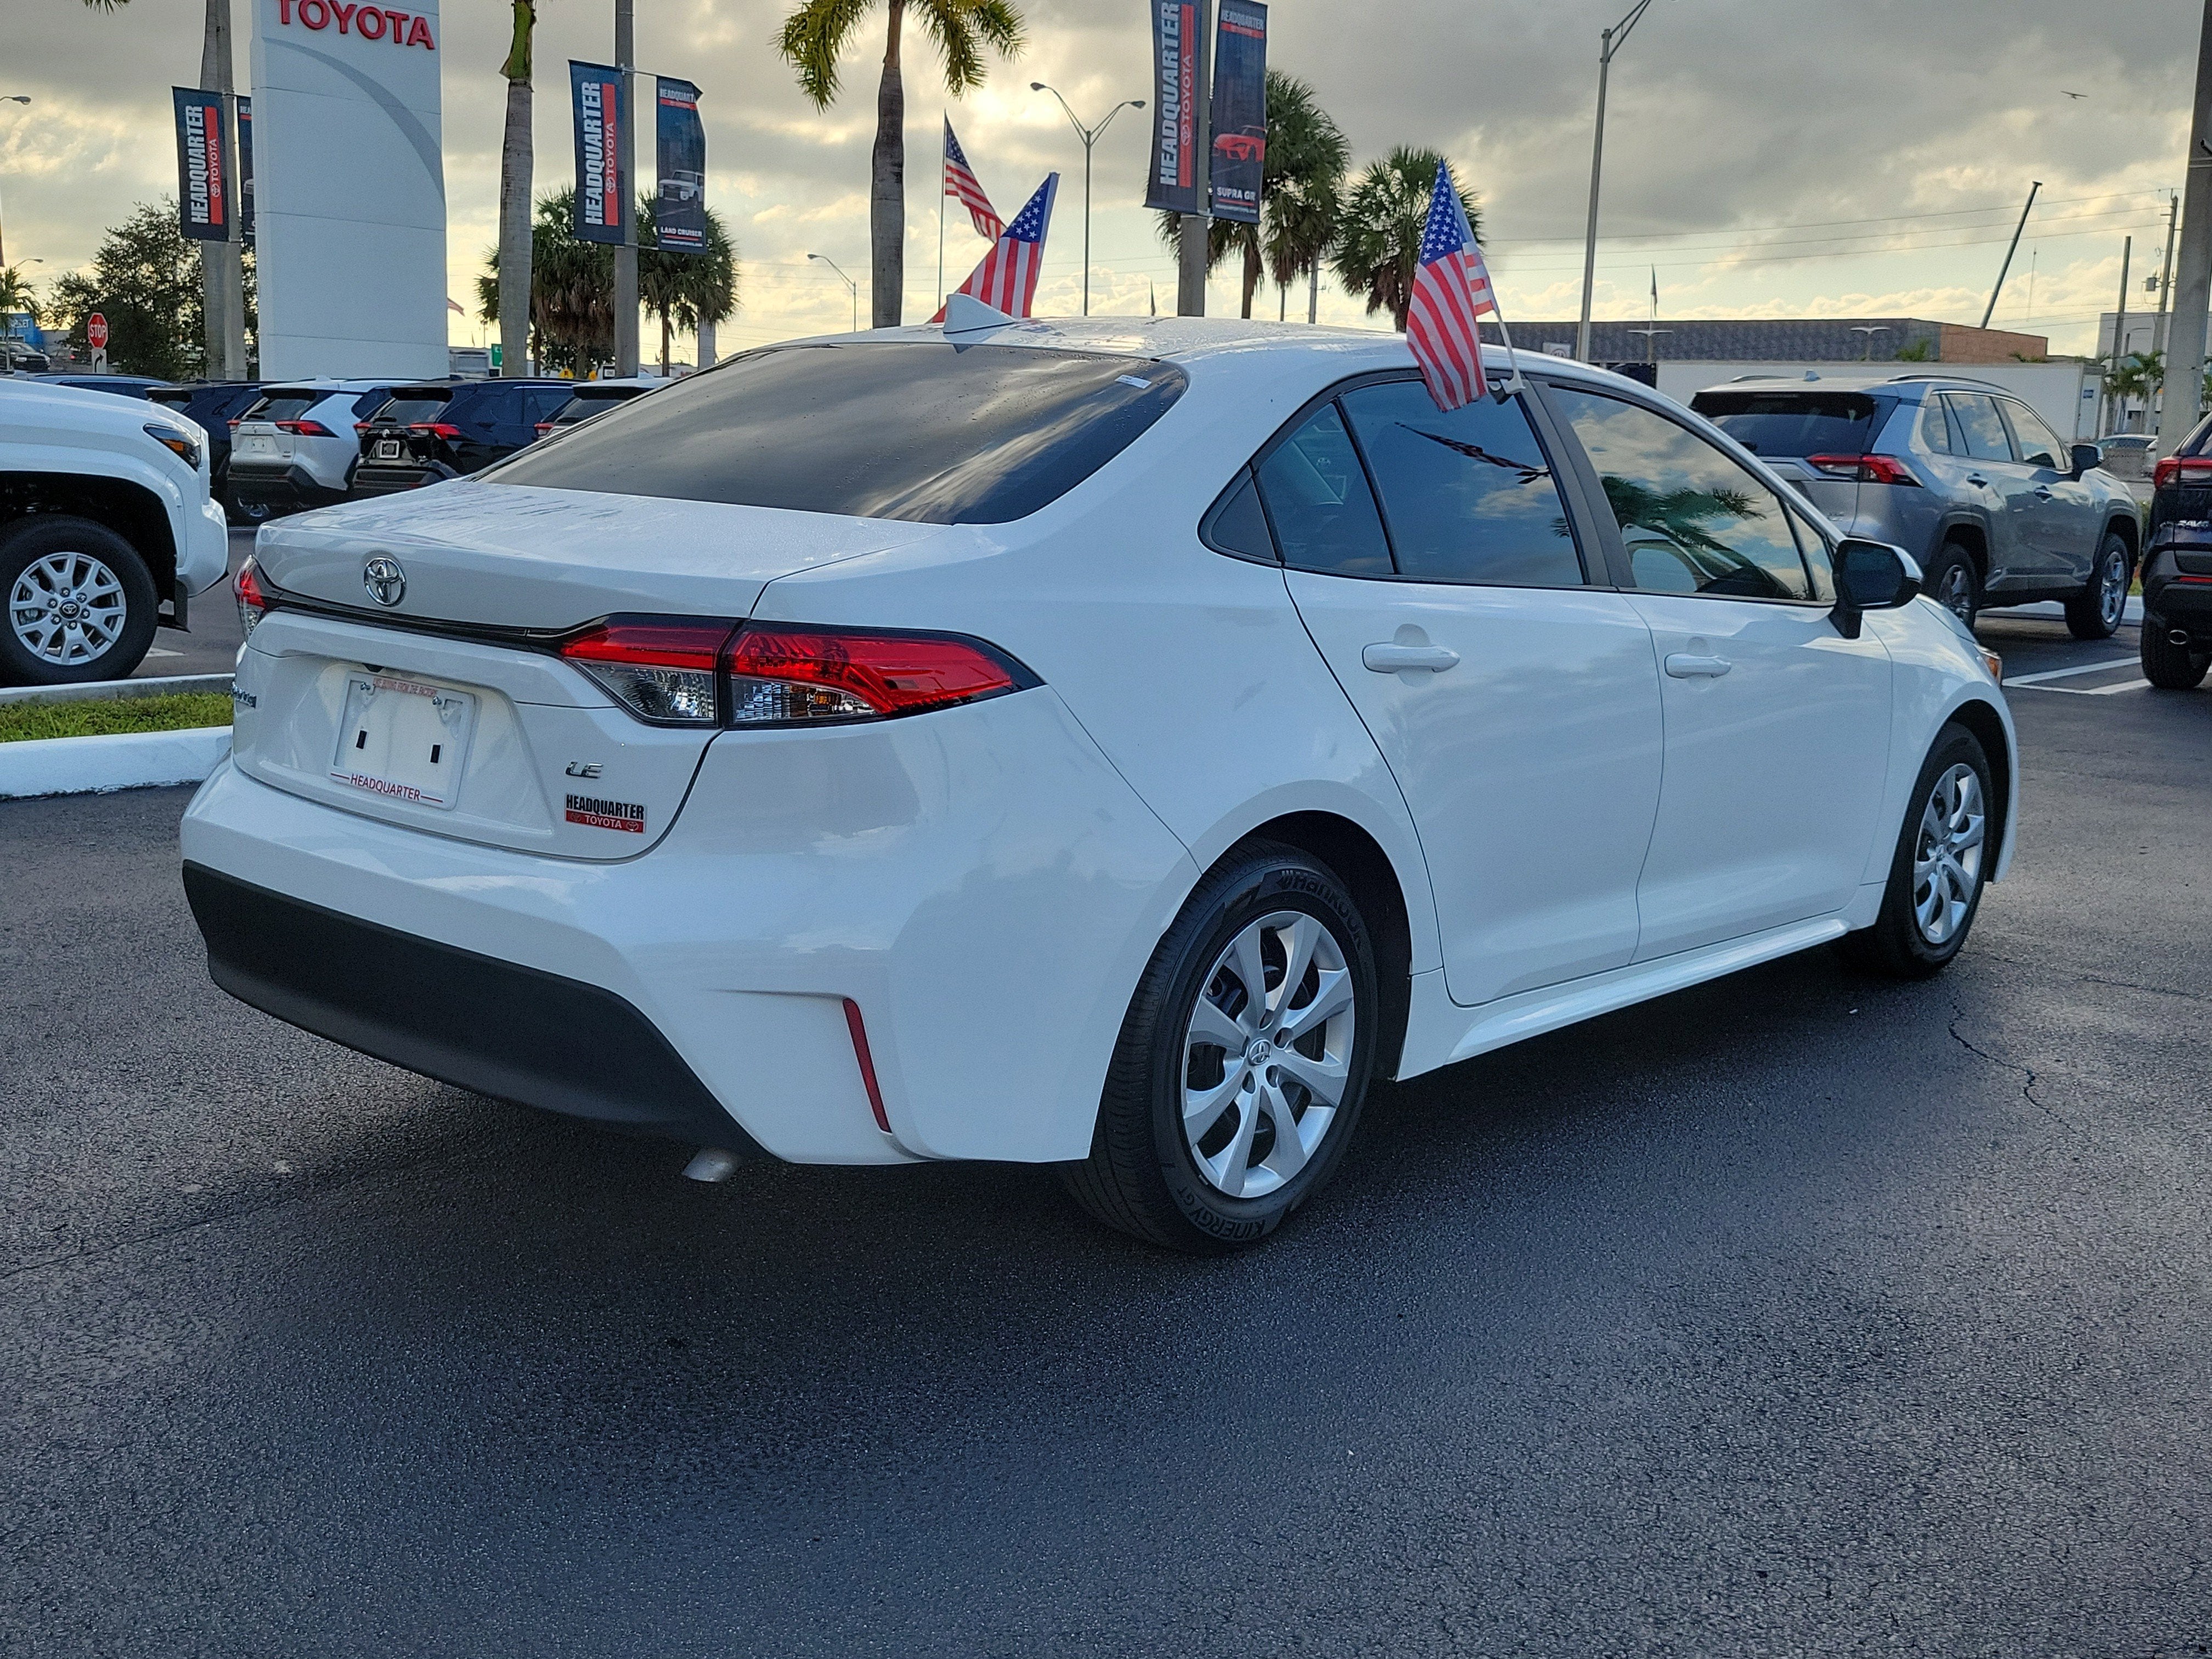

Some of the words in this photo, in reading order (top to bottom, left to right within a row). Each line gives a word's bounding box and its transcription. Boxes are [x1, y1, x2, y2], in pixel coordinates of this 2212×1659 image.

[276, 0, 436, 50] TOYOTA
[1160, 2, 1180, 187] HEADQUARTER
[1182, 55, 1192, 119] TOYOTA
[185, 105, 209, 224] HEADQUARTER
[209, 139, 220, 183] TOYOTA
[582, 82, 605, 225] HEADQUARTER
[606, 122, 615, 175] TOYOTA
[1216, 187, 1243, 199] SUPRA
[90, 324, 106, 338] STOP
[350, 773, 421, 801] HEADQUARTER
[566, 761, 603, 778] LE
[566, 794, 645, 820] HEADQUARTER
[585, 815, 623, 829] TOYOTA
[1188, 1207, 1266, 1239] KINERGY
